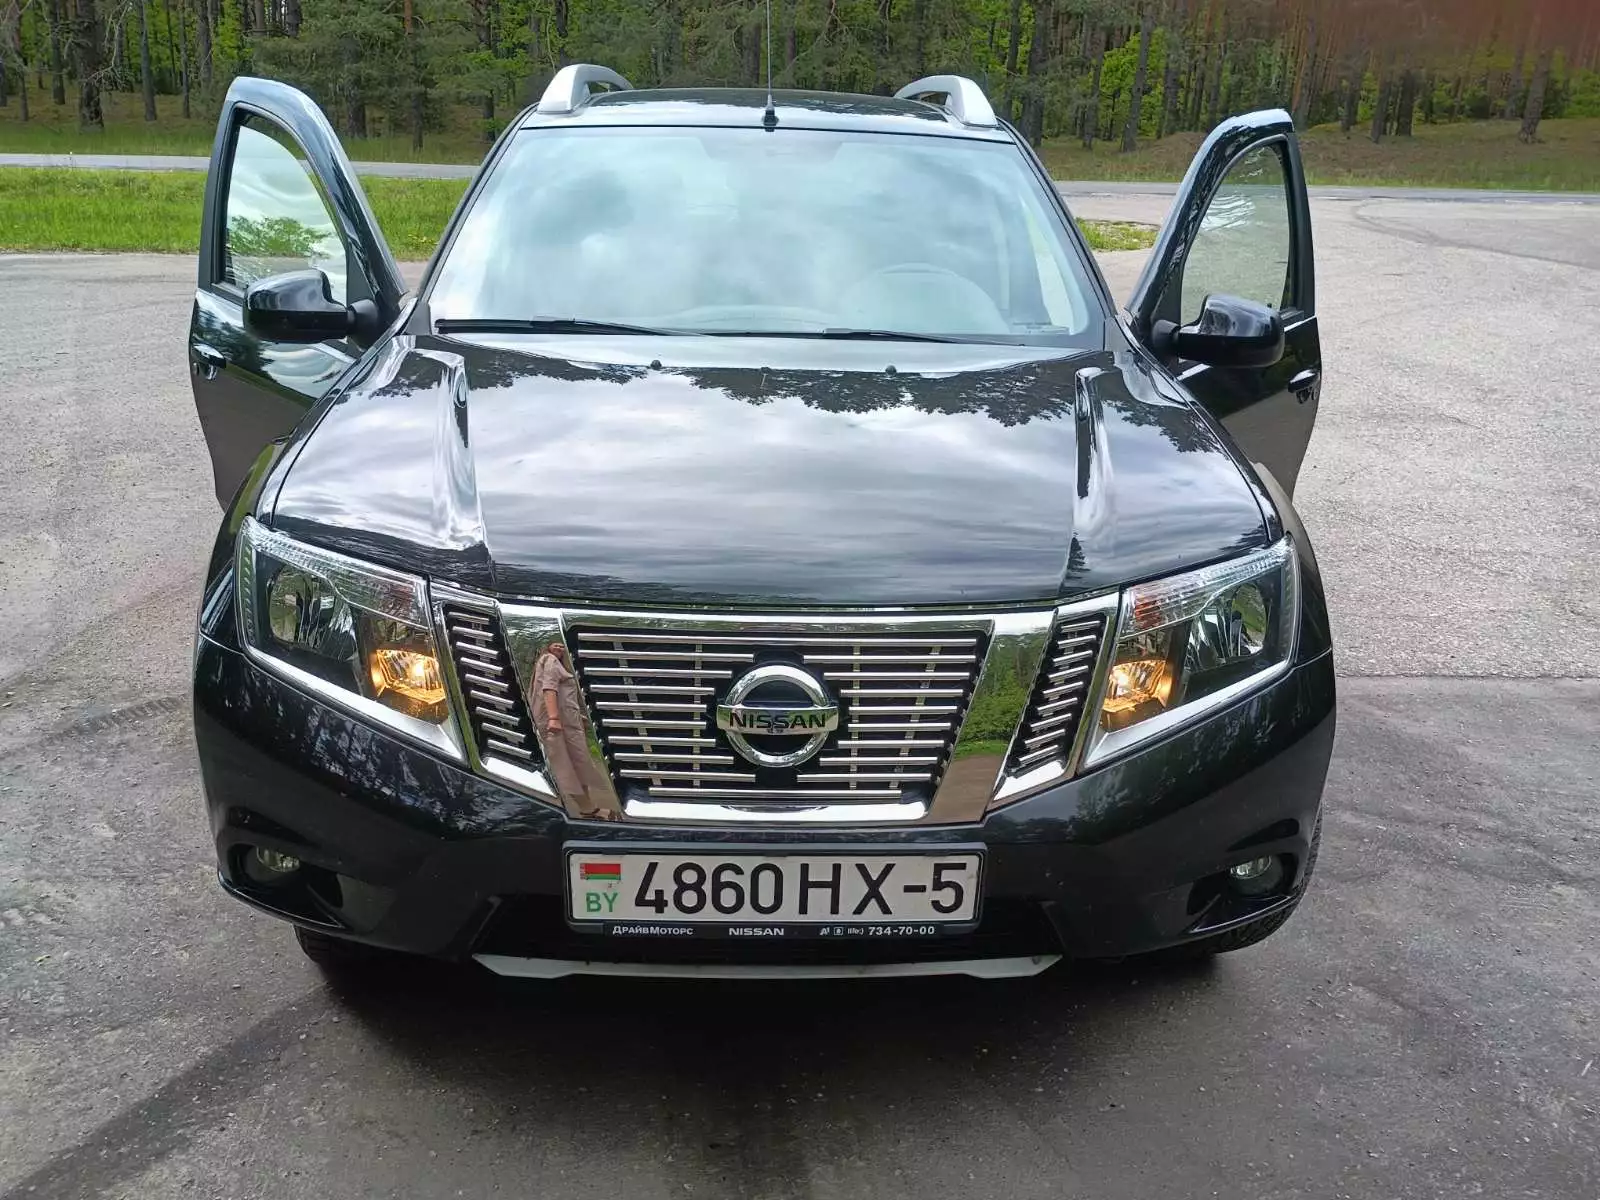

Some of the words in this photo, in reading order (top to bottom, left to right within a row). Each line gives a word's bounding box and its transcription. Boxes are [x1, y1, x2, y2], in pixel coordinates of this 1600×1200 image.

[729, 712, 826, 729] NISSAN
[634, 861, 784, 915] 4860
[798, 862, 968, 915] HX-5
[585, 892, 618, 913] BY
[728, 927, 785, 937] NISSAN
[868, 926, 935, 936] 734-70-00
